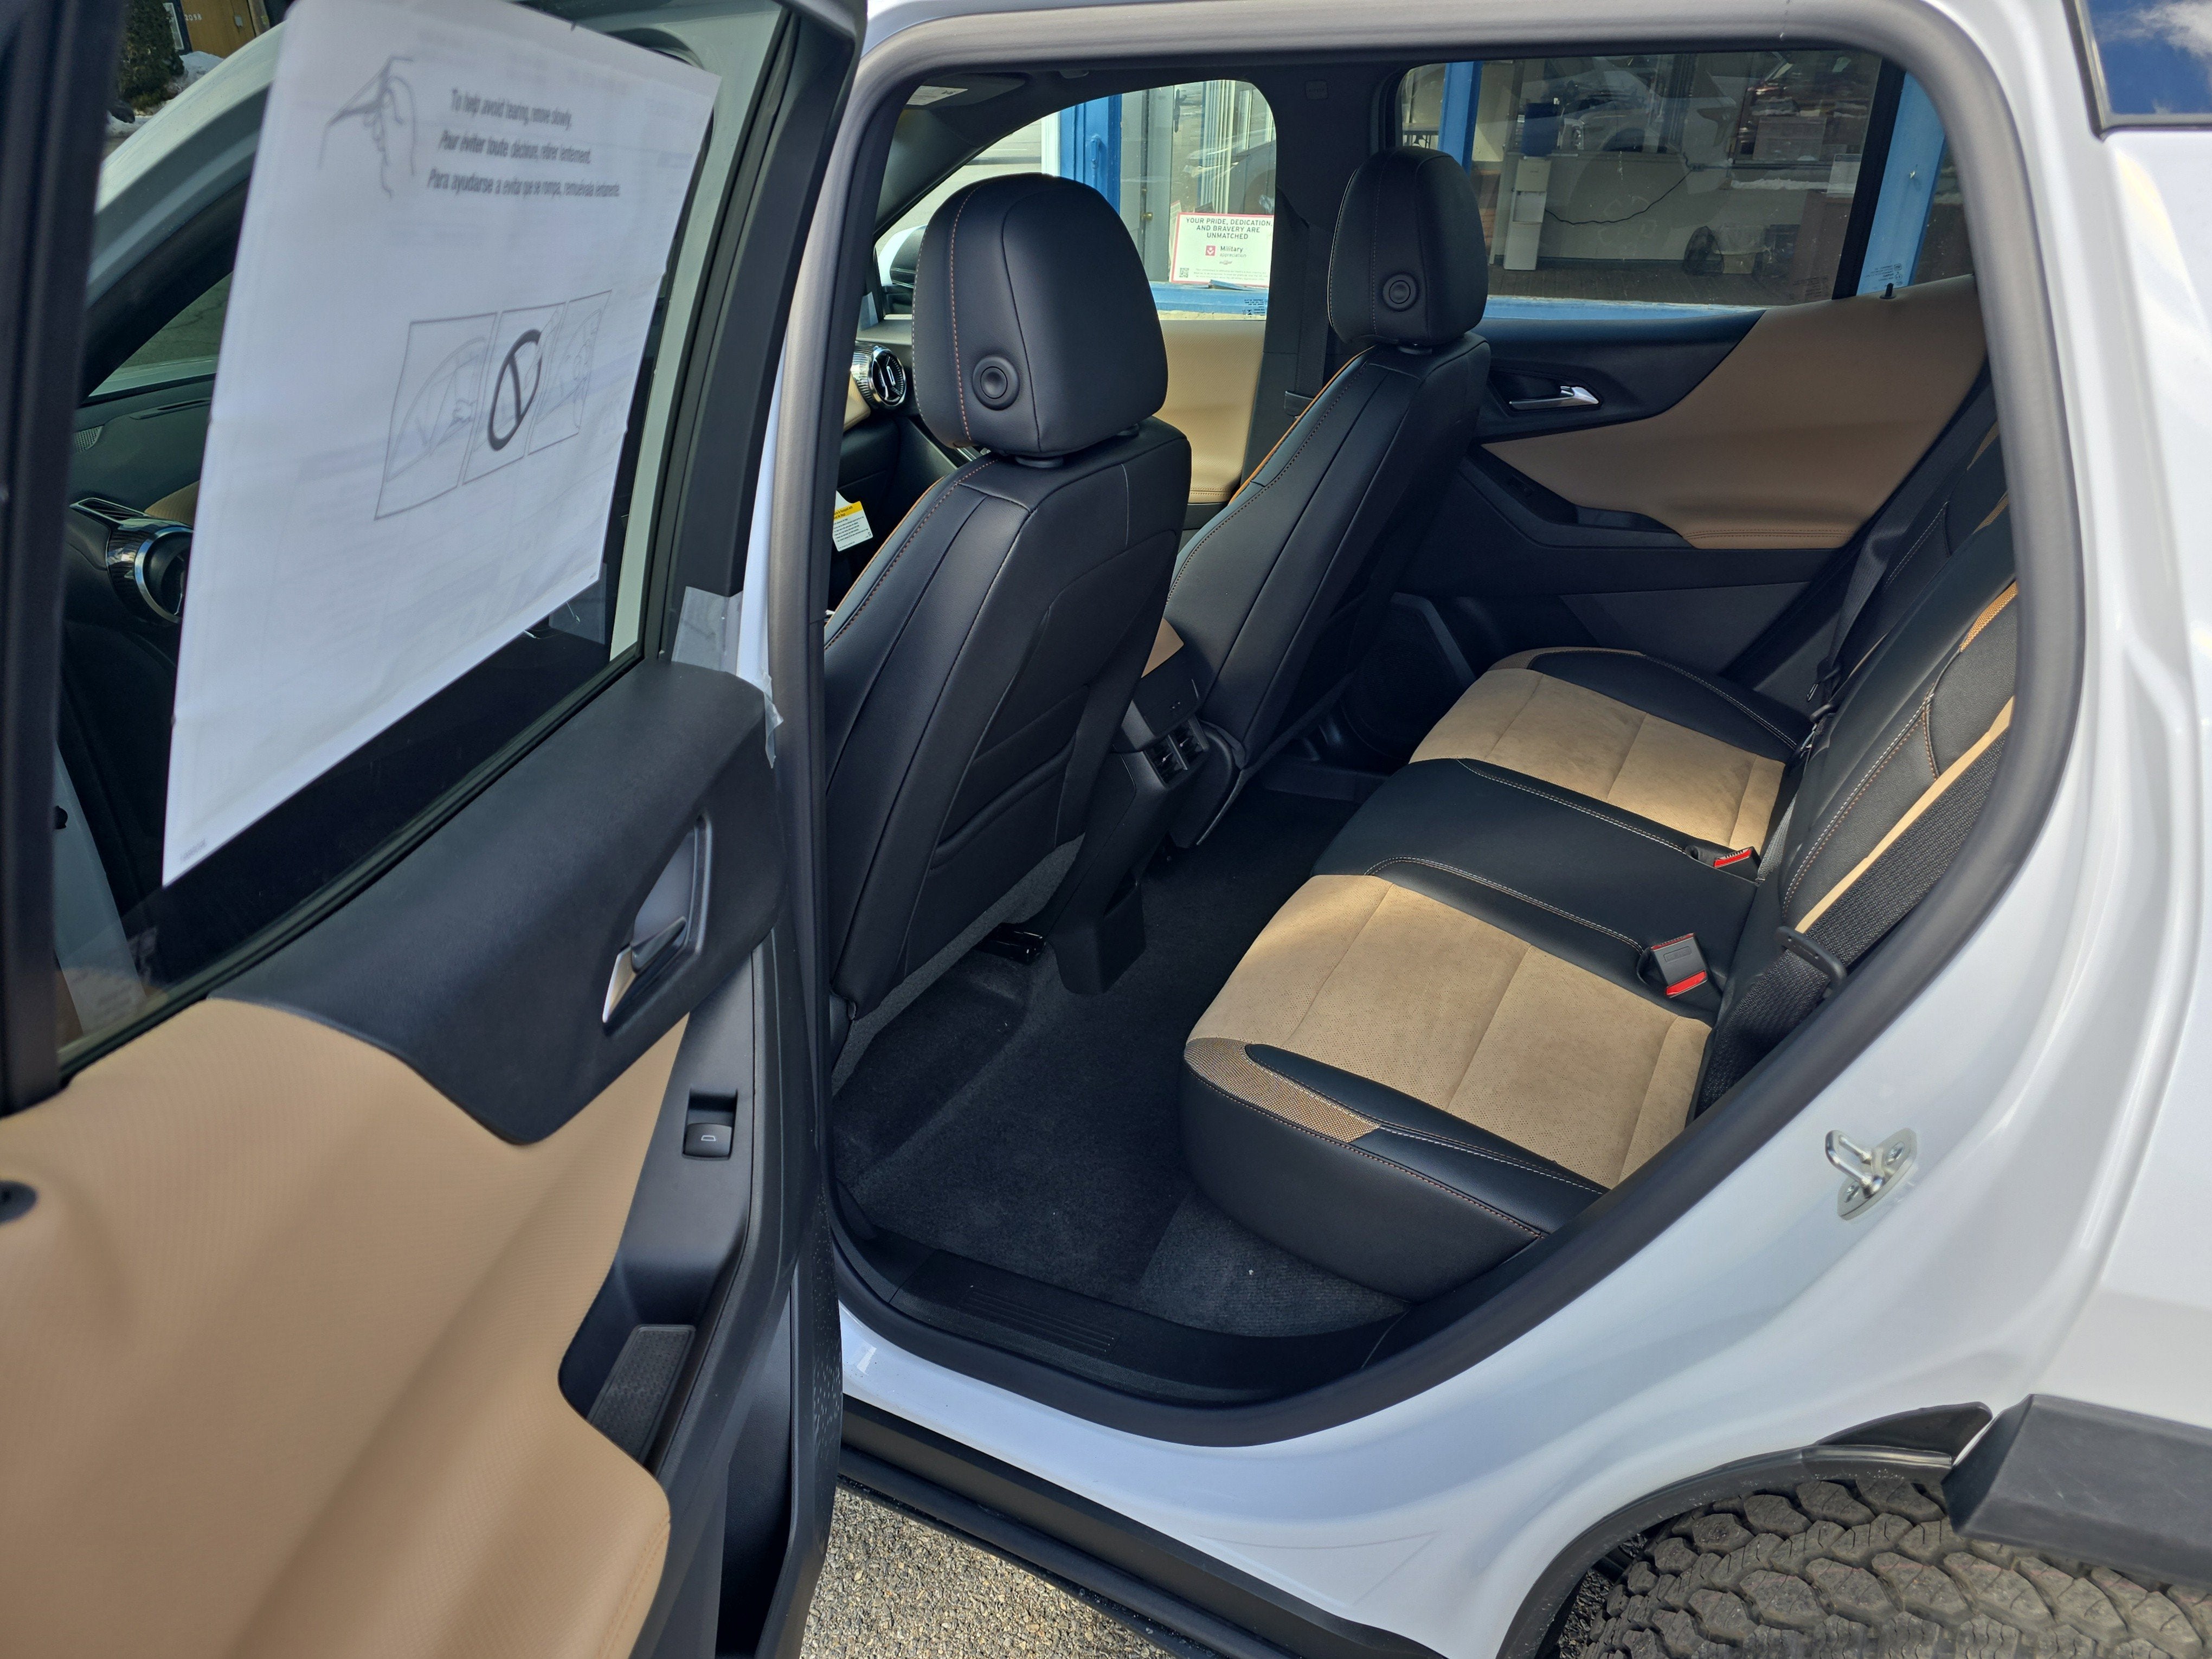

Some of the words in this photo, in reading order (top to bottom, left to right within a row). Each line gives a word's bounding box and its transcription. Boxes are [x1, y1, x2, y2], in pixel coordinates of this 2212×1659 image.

[451, 88, 461, 111] To
[481, 98, 504, 118] avoid
[427, 168, 449, 190] Para
